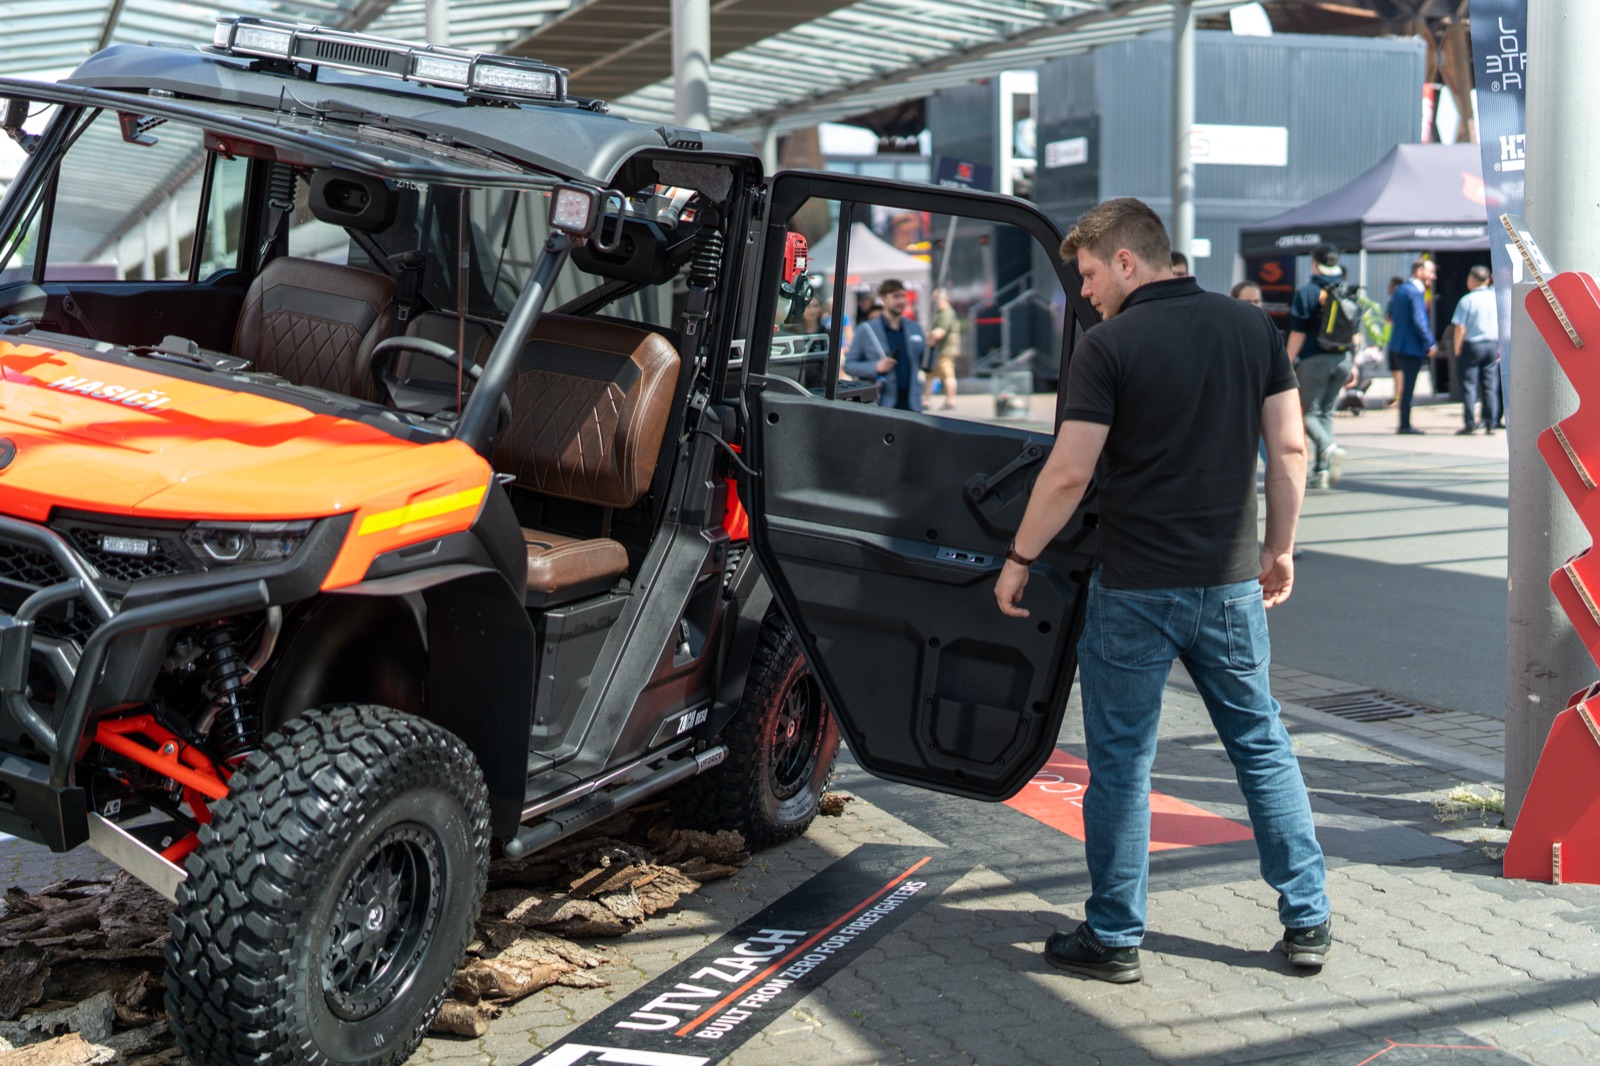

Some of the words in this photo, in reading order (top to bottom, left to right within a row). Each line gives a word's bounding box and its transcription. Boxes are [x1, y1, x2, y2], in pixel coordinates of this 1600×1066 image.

[47, 375, 171, 410] HASIČI
[677, 709, 697, 735] ZACH
[615, 983, 722, 1031] UTV
[689, 928, 807, 983] ZACH
[694, 1007, 753, 1039] BUILT
[738, 978, 795, 1009] FROM
[779, 953, 827, 980] ZERO
[814, 935, 851, 954] FOR
[839, 880, 927, 940] FIREFIGHTERS
